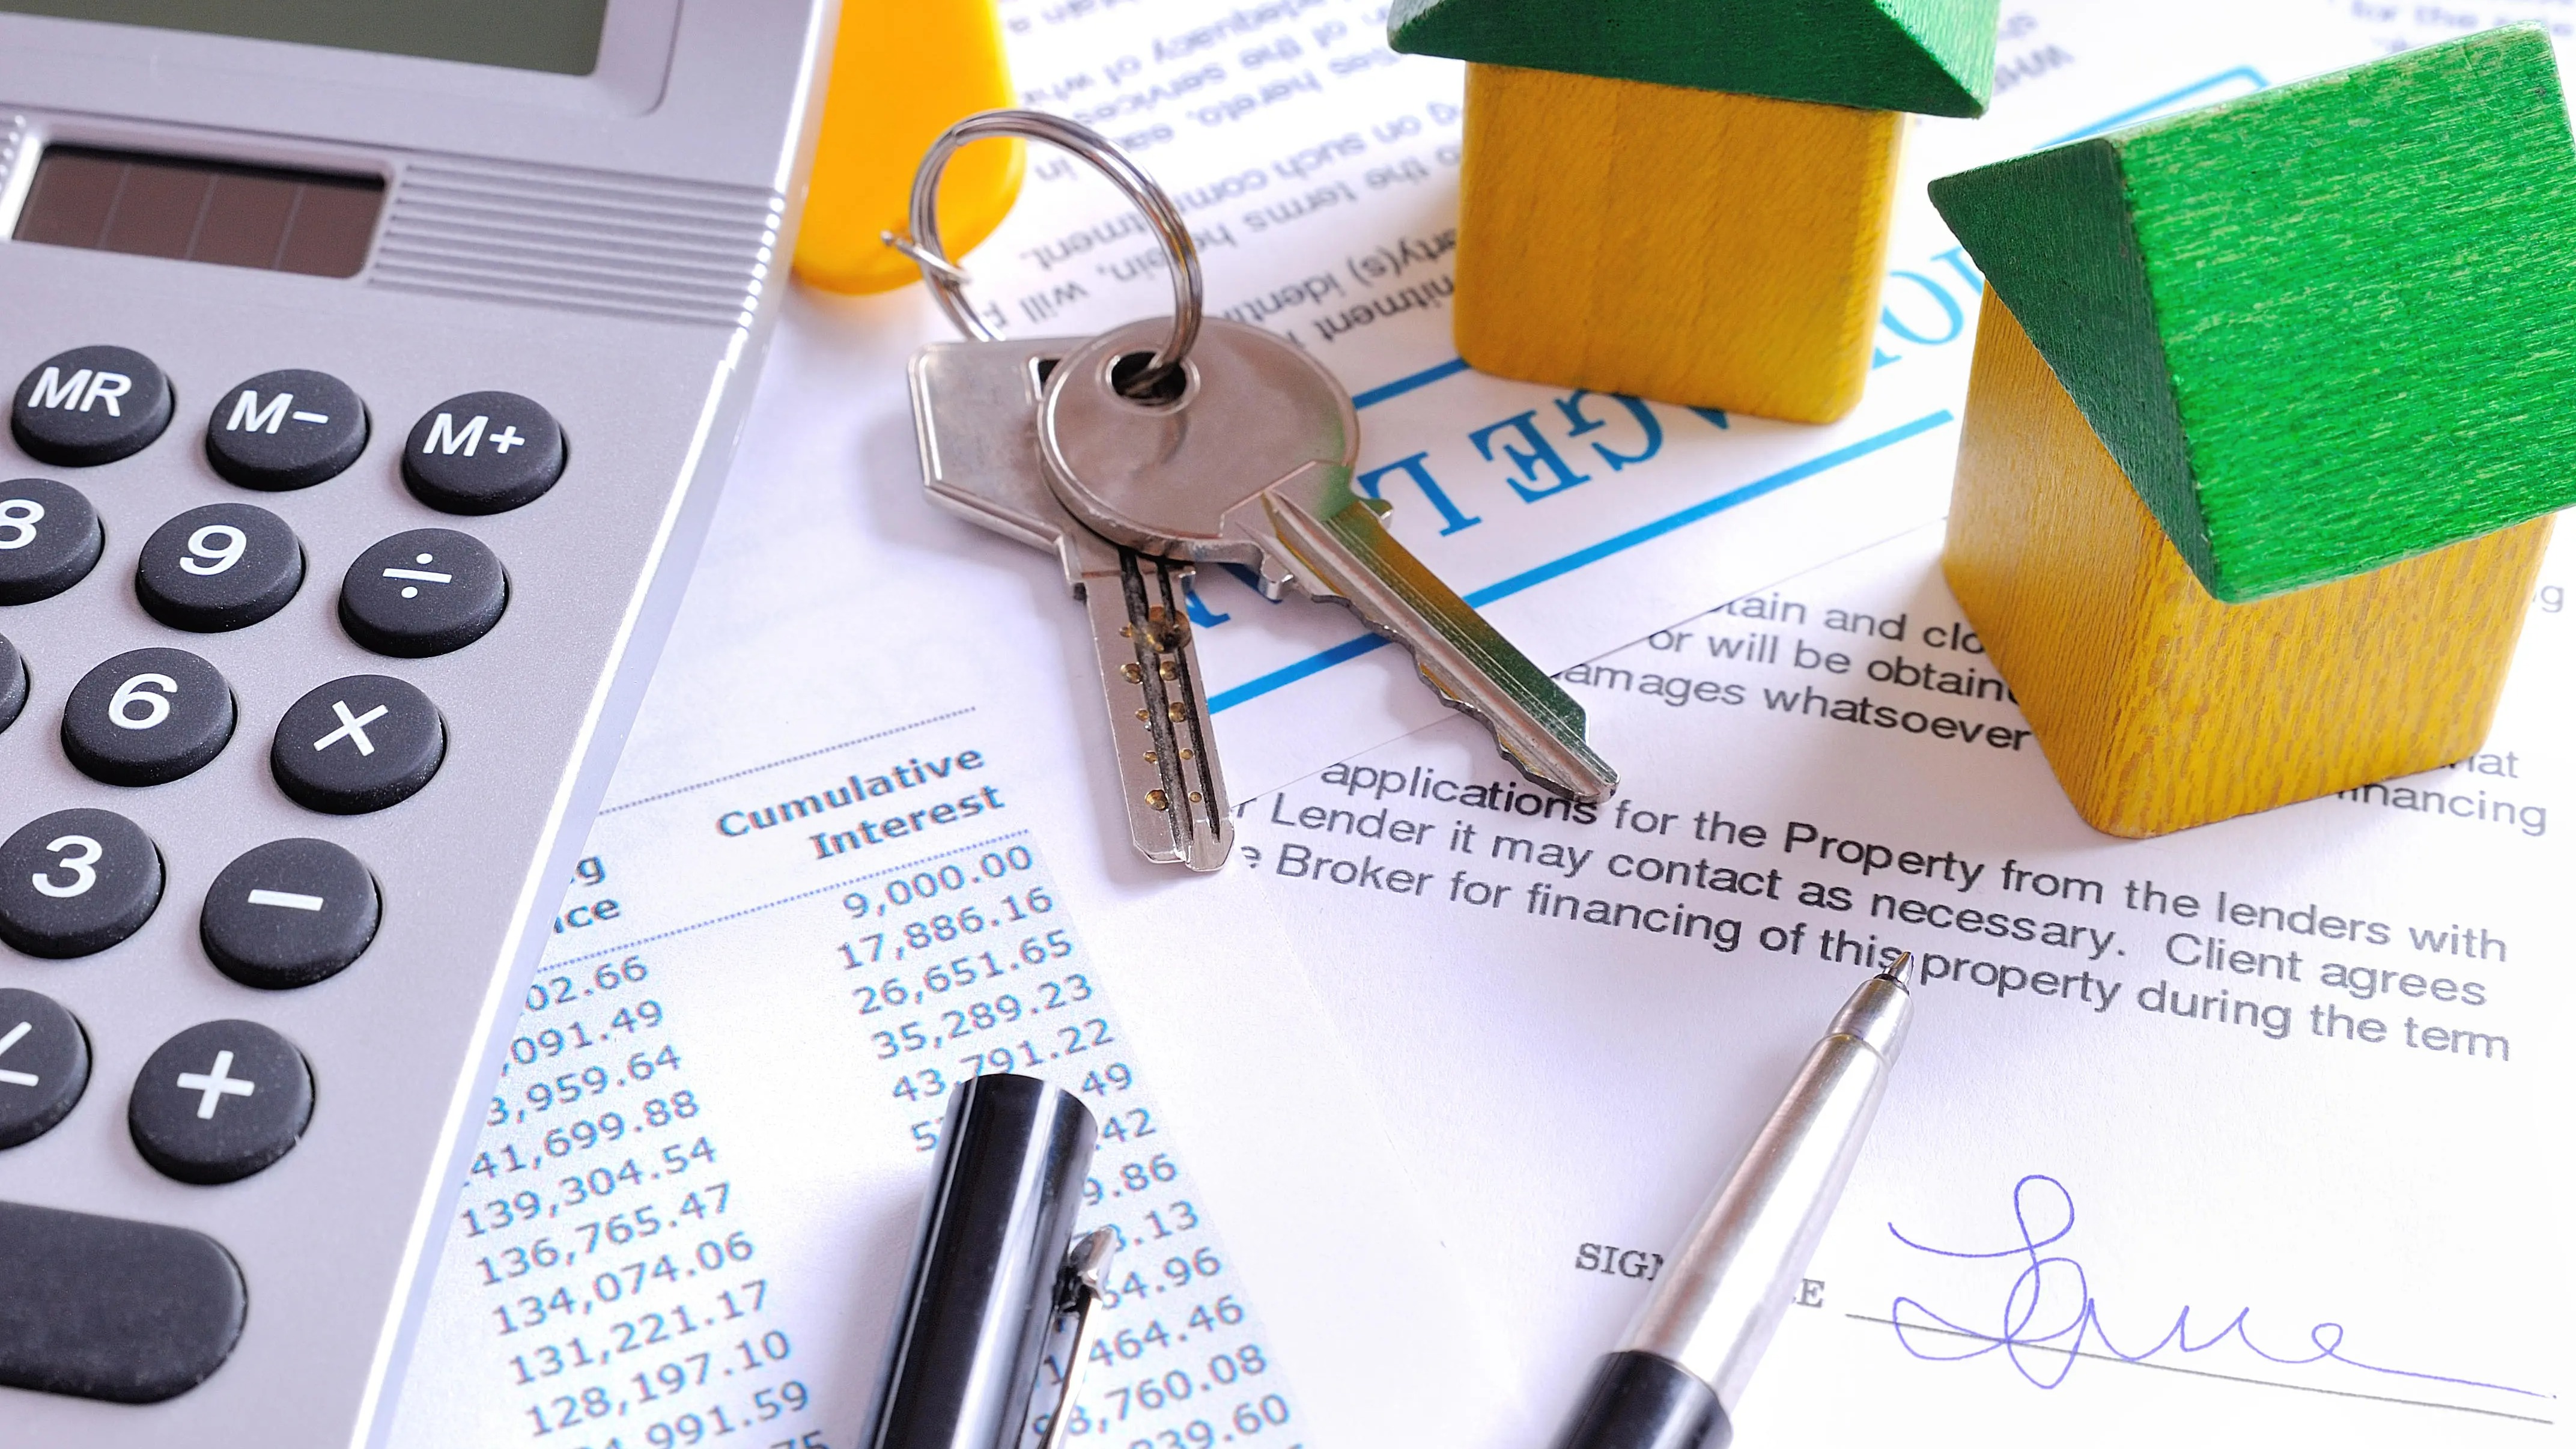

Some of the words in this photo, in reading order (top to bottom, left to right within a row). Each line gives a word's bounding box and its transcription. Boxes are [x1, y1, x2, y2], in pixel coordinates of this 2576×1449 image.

[1244, 183, 1357, 238] terms
[1347, 229, 1456, 288] arty(s)
[1019, 282, 1089, 326] will
[28, 367, 131, 416] MR
[423, 413, 525, 457] M+
[0, 499, 44, 549] 8
[180, 525, 246, 576] 9
[1824, 614, 1907, 643] and
[109, 673, 178, 729] 6
[1648, 630, 1694, 652] or
[1708, 633, 1779, 664] will
[1794, 639, 1851, 675] be
[1867, 655, 2019, 705] obtain
[1553, 663, 1746, 708] amages
[1764, 685, 2032, 751] whatsoever
[716, 746, 984, 838] Cumulative
[809, 785, 1004, 860] Interest
[32, 835, 103, 898] 3
[843, 845, 1033, 919] 9,000.00
[1271, 792, 1436, 846] Lender
[1450, 820, 1477, 854] it
[1491, 835, 1593, 878] may
[1608, 851, 1782, 901] contact
[1799, 879, 1853, 912] as
[1871, 893, 2126, 961] necessary.
[2166, 932, 2303, 983] Client
[2319, 963, 2487, 1006] agrees
[1321, 762, 1598, 825] applications
[1615, 800, 1678, 835] for
[1694, 811, 1767, 848] the
[1784, 822, 1985, 892] Property
[2001, 860, 2103, 905] from
[2124, 879, 2201, 918] the
[2216, 891, 2391, 945] lenders
[2408, 924, 2507, 962] with
[521, 955, 648, 1016] 02.66
[838, 886, 1053, 970] 17,886.16
[554, 899, 620, 933] ce
[1277, 843, 1434, 896] Broker
[1450, 870, 1511, 909] for
[1527, 882, 1742, 952] financing
[1760, 922, 1807, 954] of
[1820, 929, 1903, 970] this
[1920, 953, 2122, 1013] property
[2137, 981, 2292, 1039] during
[2310, 1003, 2387, 1043] the
[2404, 1016, 2509, 1061] term
[852, 929, 1073, 1015] 26,651.65
[487, 1043, 682, 1126] 3,959.64
[872, 973, 1093, 1060] 35,289.23
[463, 1090, 700, 1188] 41,699.88
[461, 1136, 716, 1238] 139,304.54
[477, 1181, 731, 1286] 136,765.47
[492, 1230, 753, 1335] 134,074.06
[508, 1279, 767, 1385] 131,221.17
[525, 1330, 791, 1437] 128,197.10
[572, 1380, 809, 1449] 991.59
